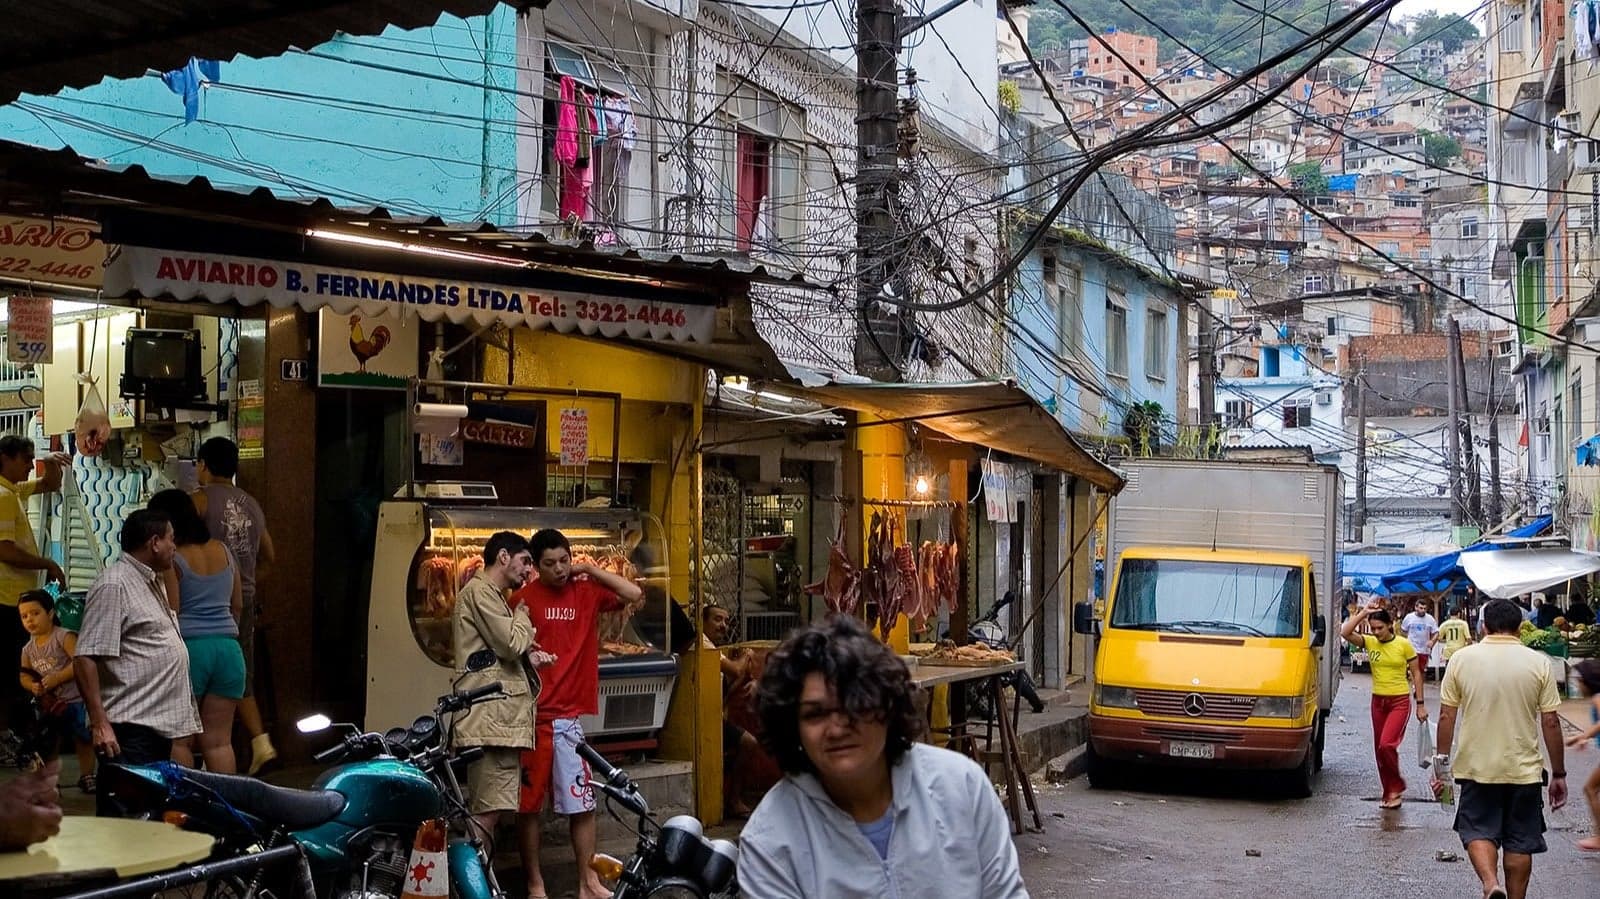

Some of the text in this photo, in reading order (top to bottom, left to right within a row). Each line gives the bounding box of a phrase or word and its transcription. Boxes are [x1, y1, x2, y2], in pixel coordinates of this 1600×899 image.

[156, 256, 687, 328] AVIARIO B. FERNANDES LTDA Tel: 3322-4446
[289, 362, 302, 379] 41
[1448, 627, 1459, 641] 11
